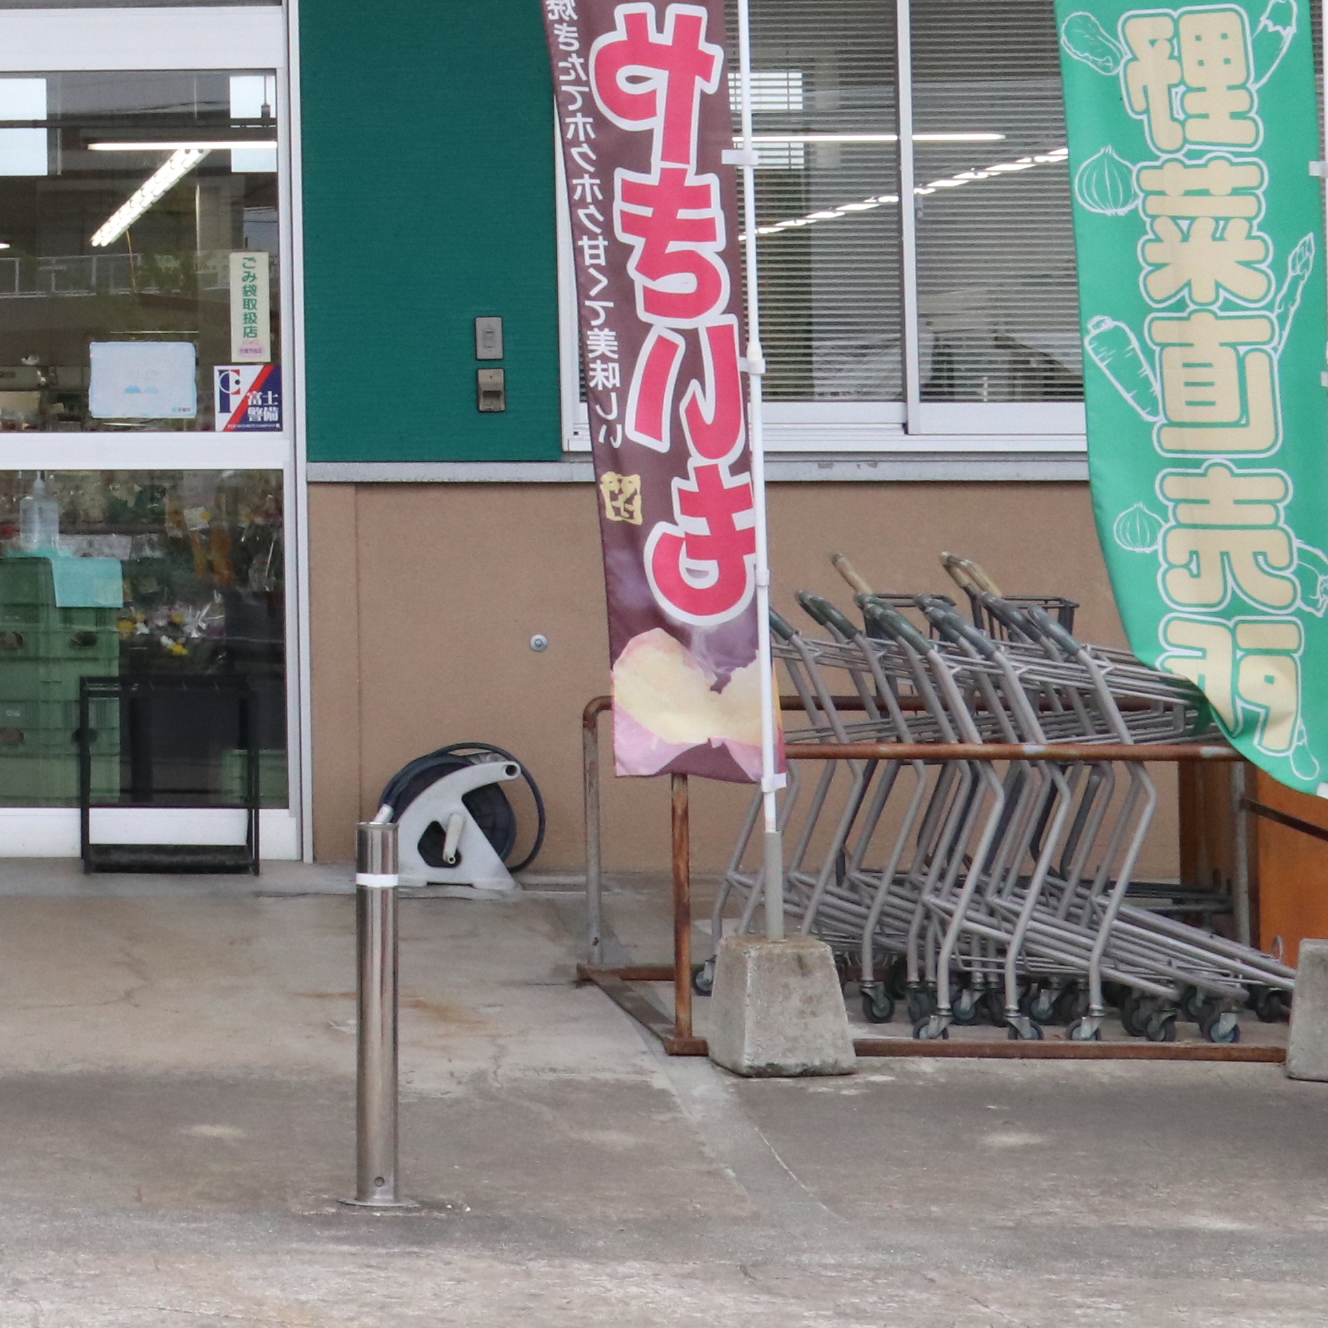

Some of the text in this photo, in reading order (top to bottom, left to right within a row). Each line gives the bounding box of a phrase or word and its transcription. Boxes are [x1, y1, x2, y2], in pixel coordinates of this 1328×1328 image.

[241, 257, 258, 339] ごみ袋取扱店
[247, 391, 278, 405] 富士
[247, 407, 279, 422] 警備
